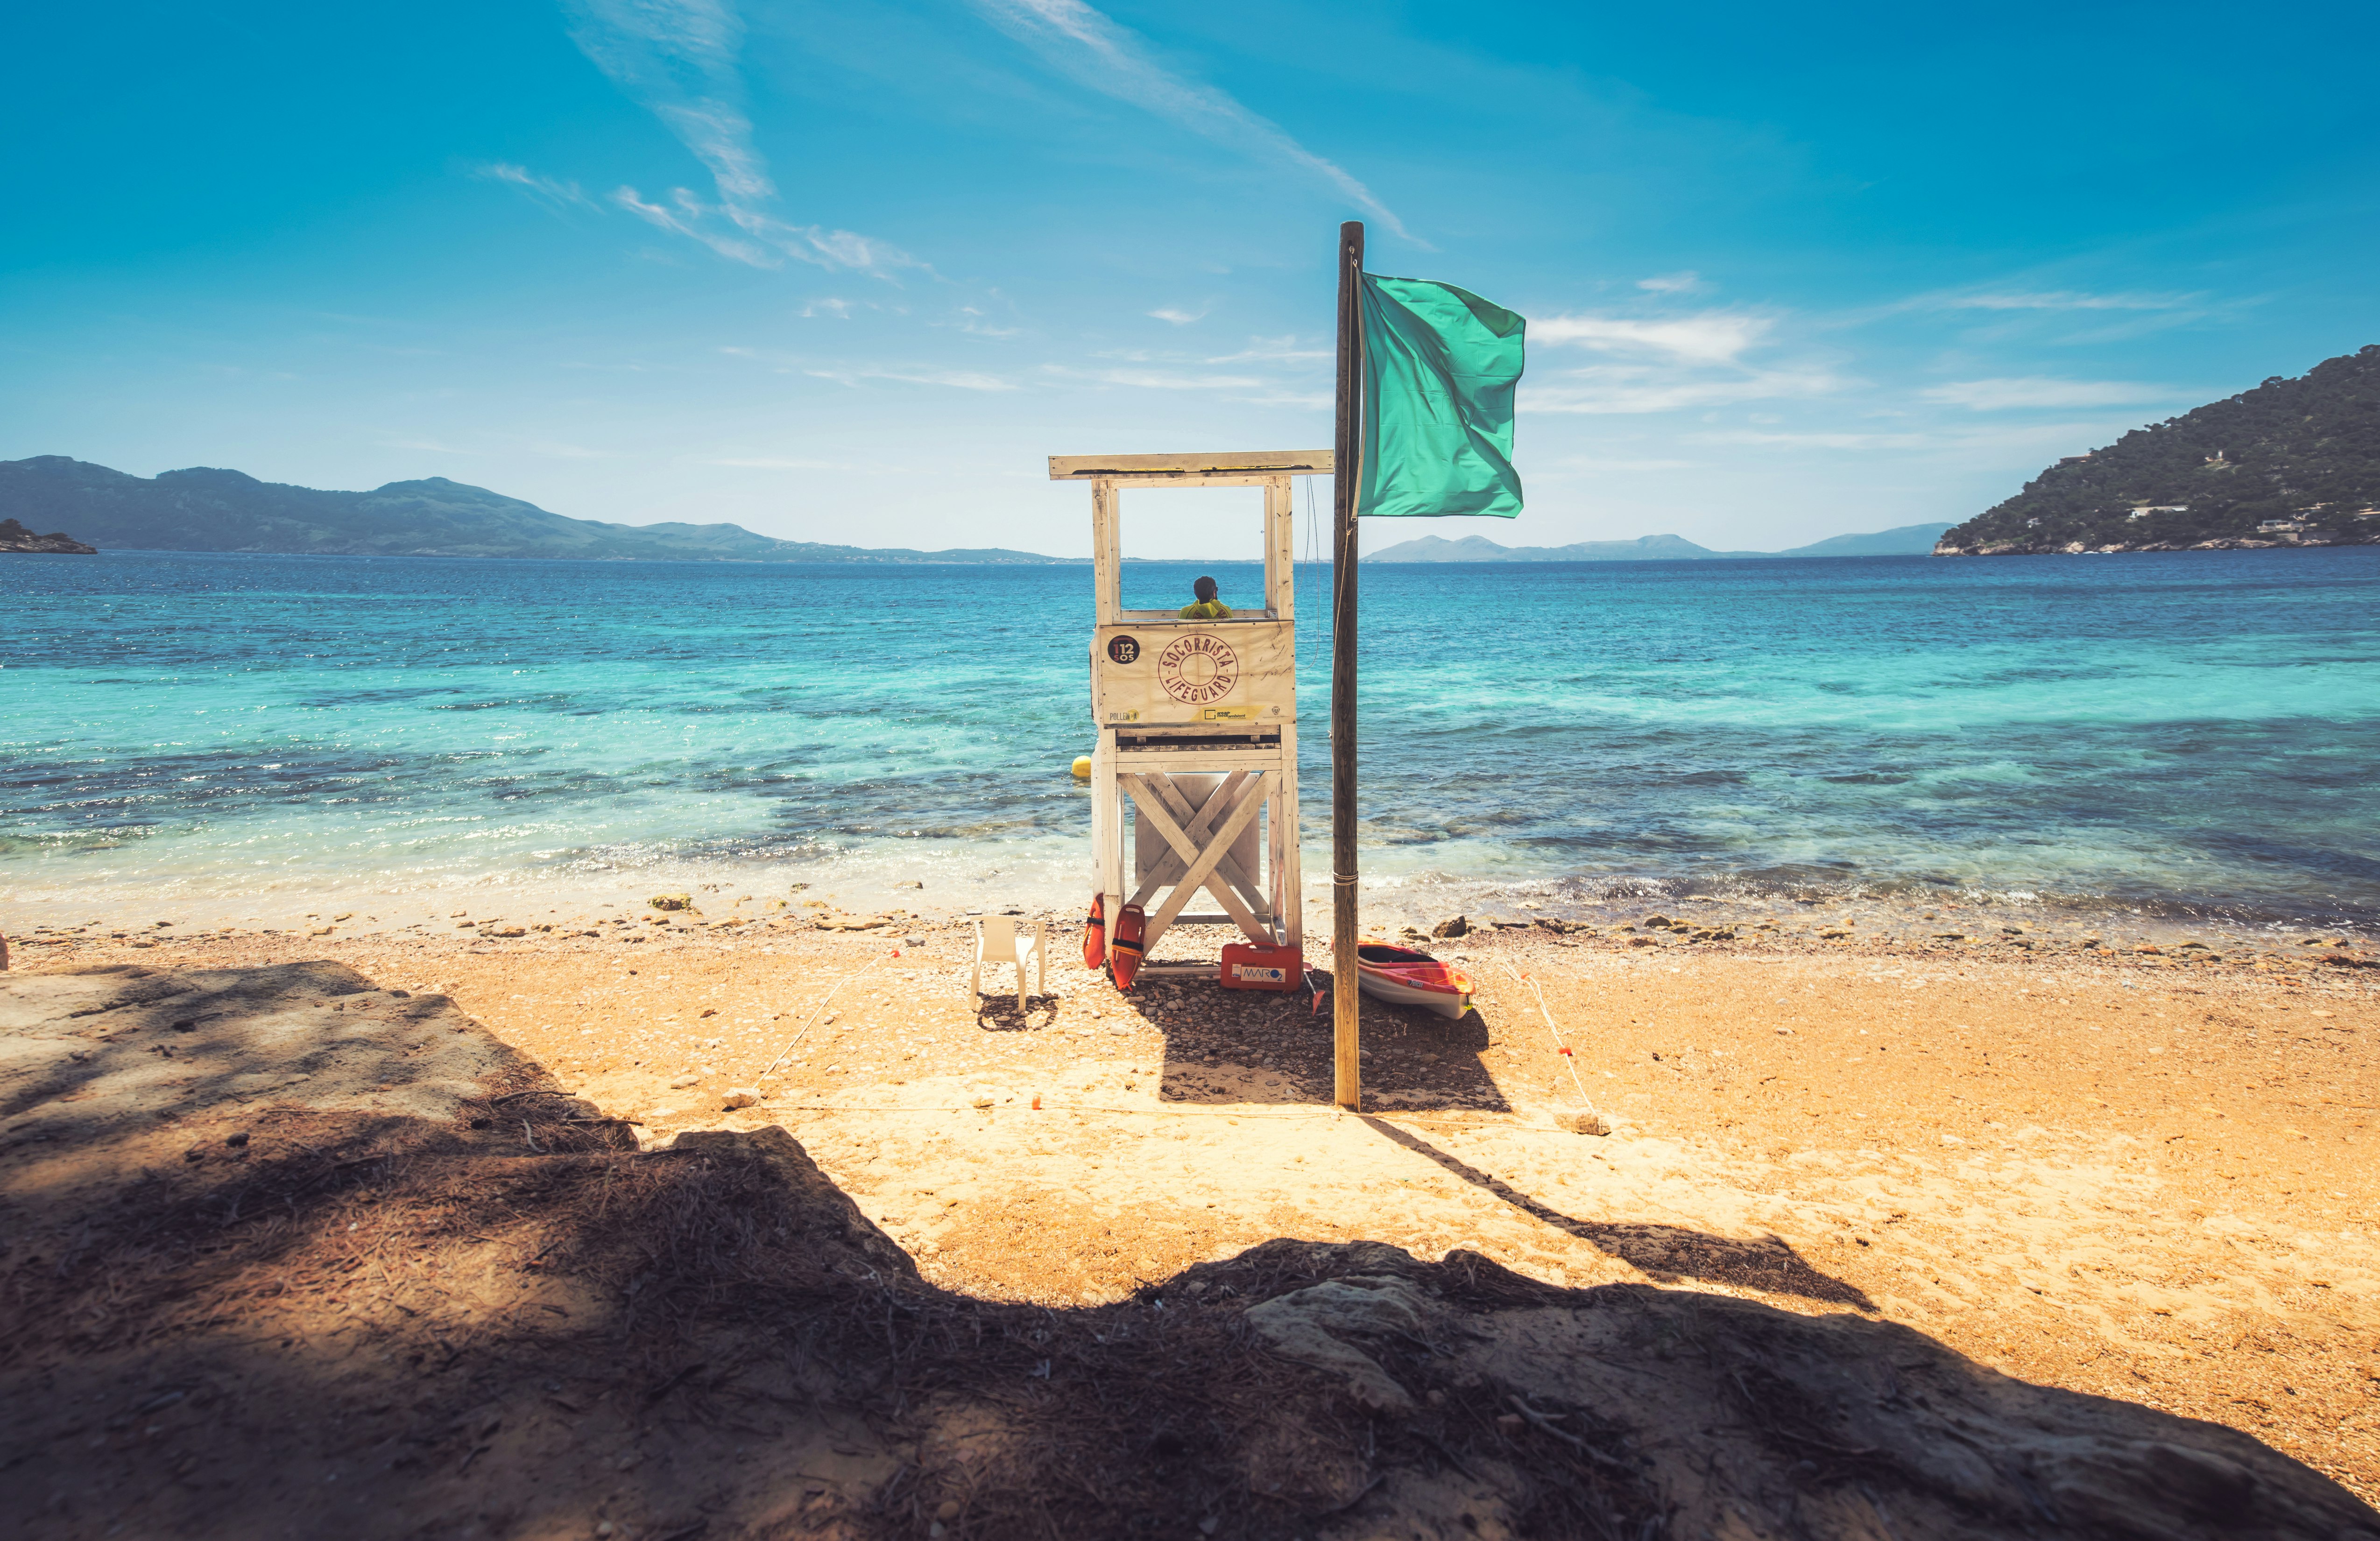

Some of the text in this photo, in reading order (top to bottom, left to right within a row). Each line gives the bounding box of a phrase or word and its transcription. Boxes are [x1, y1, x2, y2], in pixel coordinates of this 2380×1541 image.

[1113, 643, 1134, 654] 112
[1162, 638, 1234, 668] SOCORRISTA
[1165, 676, 1231, 702] LIFEGUARD
